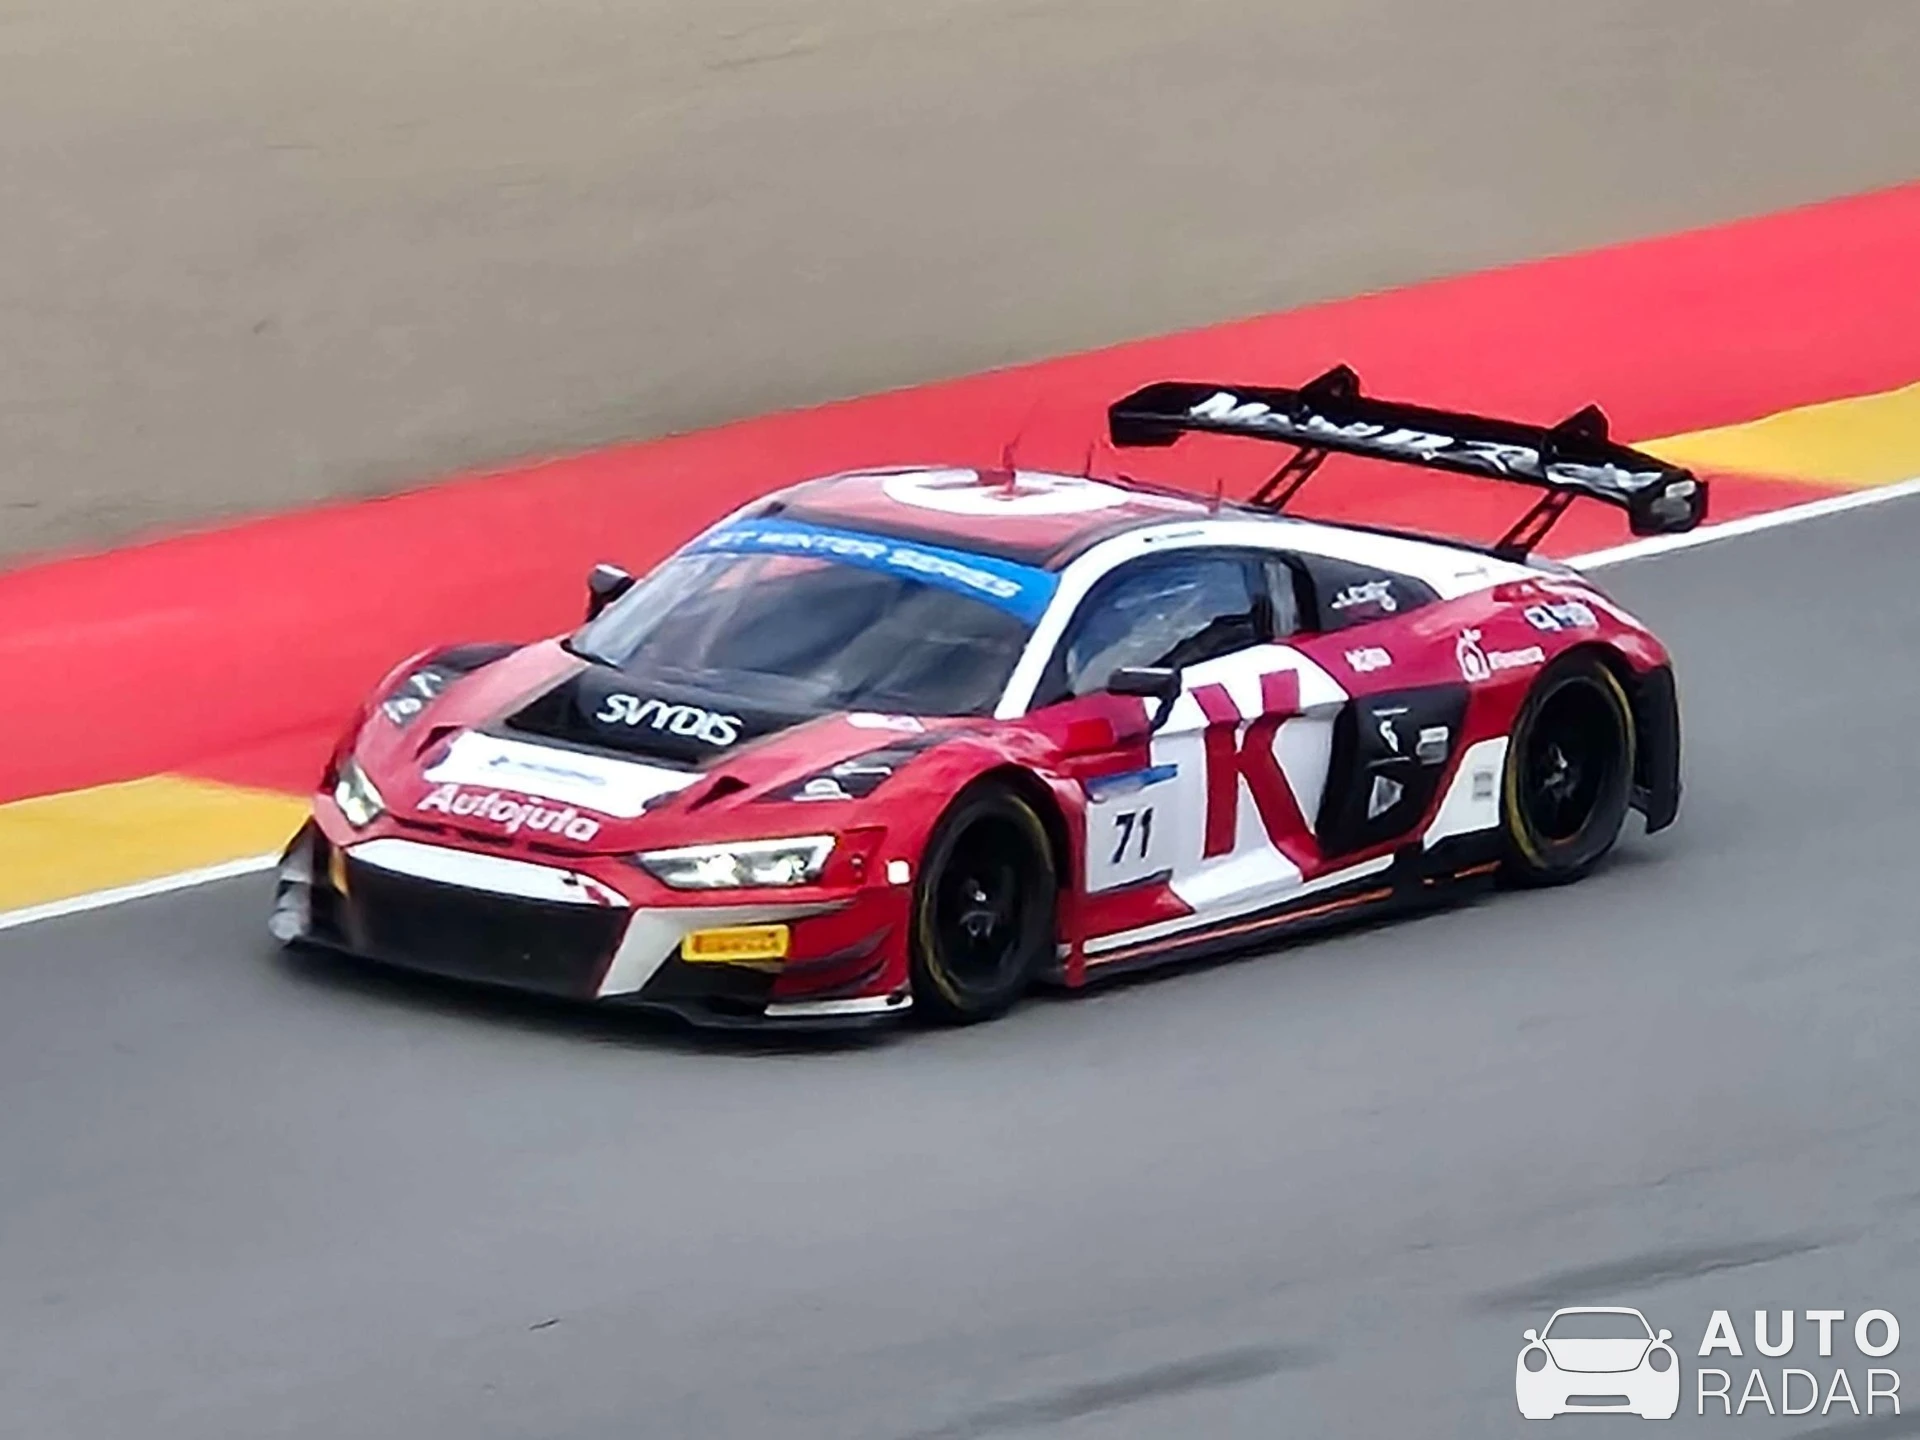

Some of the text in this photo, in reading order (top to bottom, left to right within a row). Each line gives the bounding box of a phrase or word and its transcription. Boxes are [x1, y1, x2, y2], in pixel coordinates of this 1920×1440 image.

[596, 693, 743, 746] SVYDIS
[417, 782, 600, 842] Autojuta
[1112, 806, 1154, 864] 71
